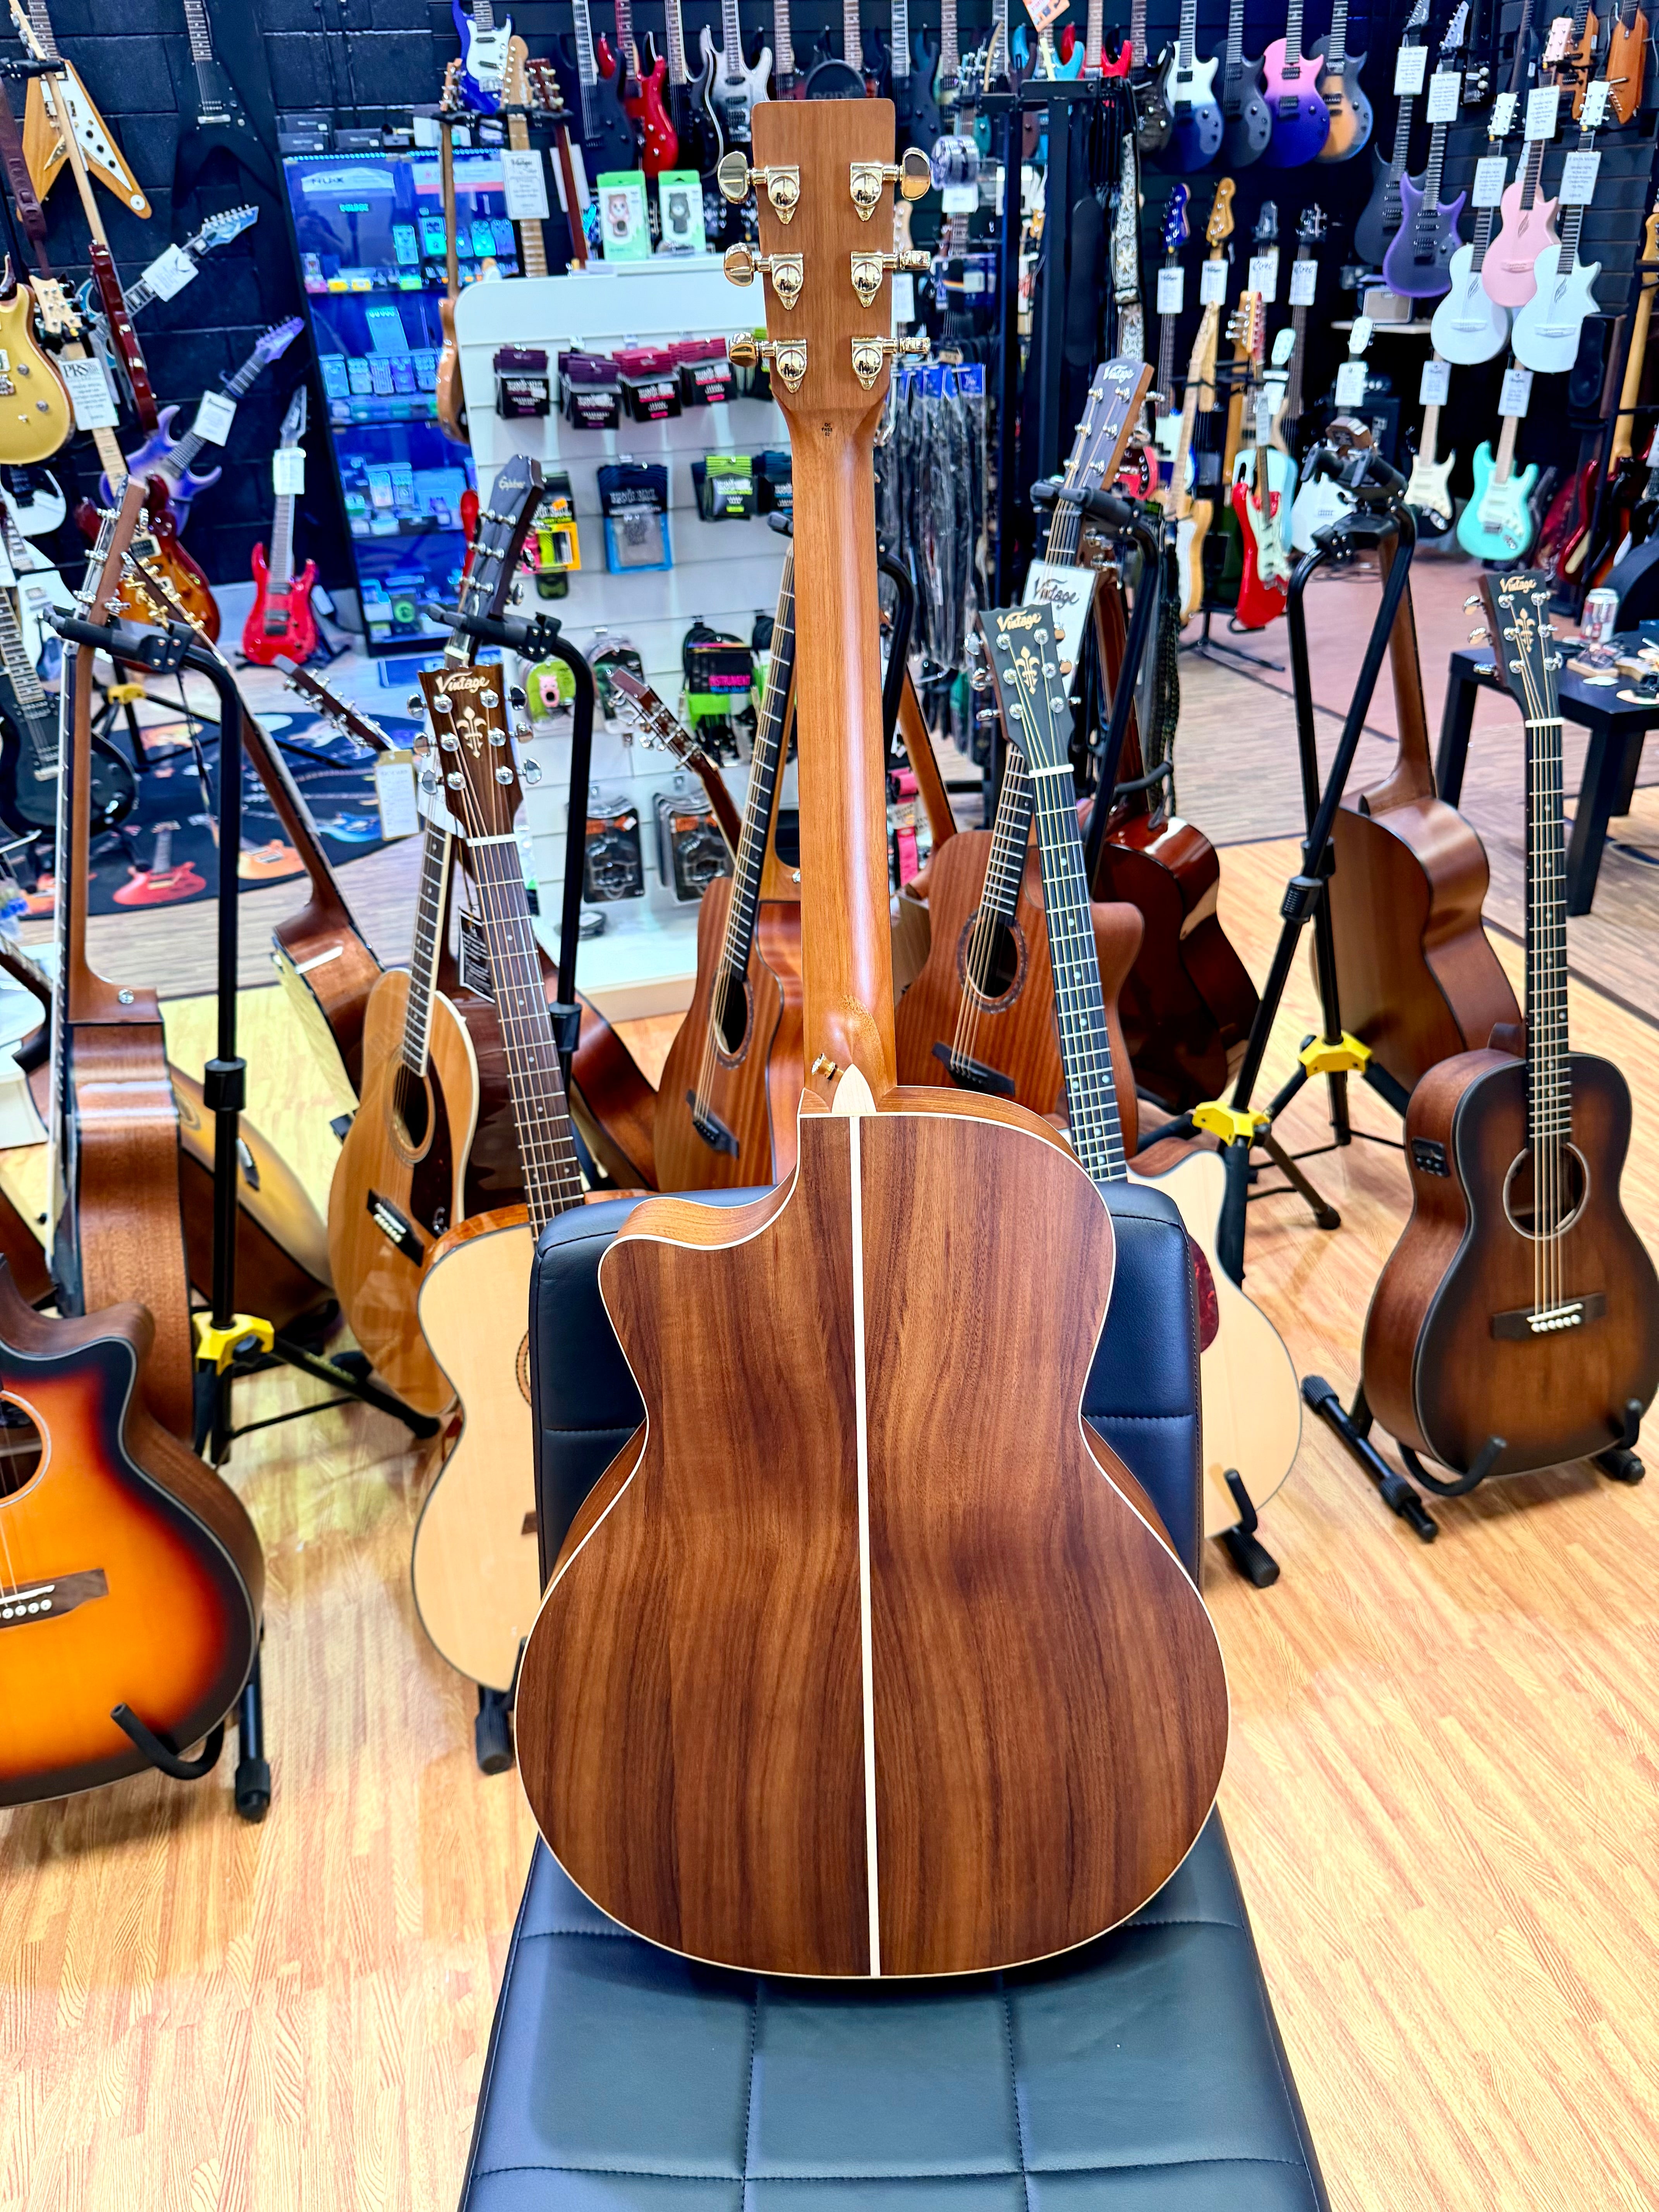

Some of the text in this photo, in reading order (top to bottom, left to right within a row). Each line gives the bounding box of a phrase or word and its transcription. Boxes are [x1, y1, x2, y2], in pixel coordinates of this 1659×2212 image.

[63, 362, 89, 378] PRS
[1032, 576, 1080, 610] Vintage
[1499, 574, 1537, 593] Vintage
[996, 609, 1042, 632] Vintage
[435, 671, 490, 694] Vintage
